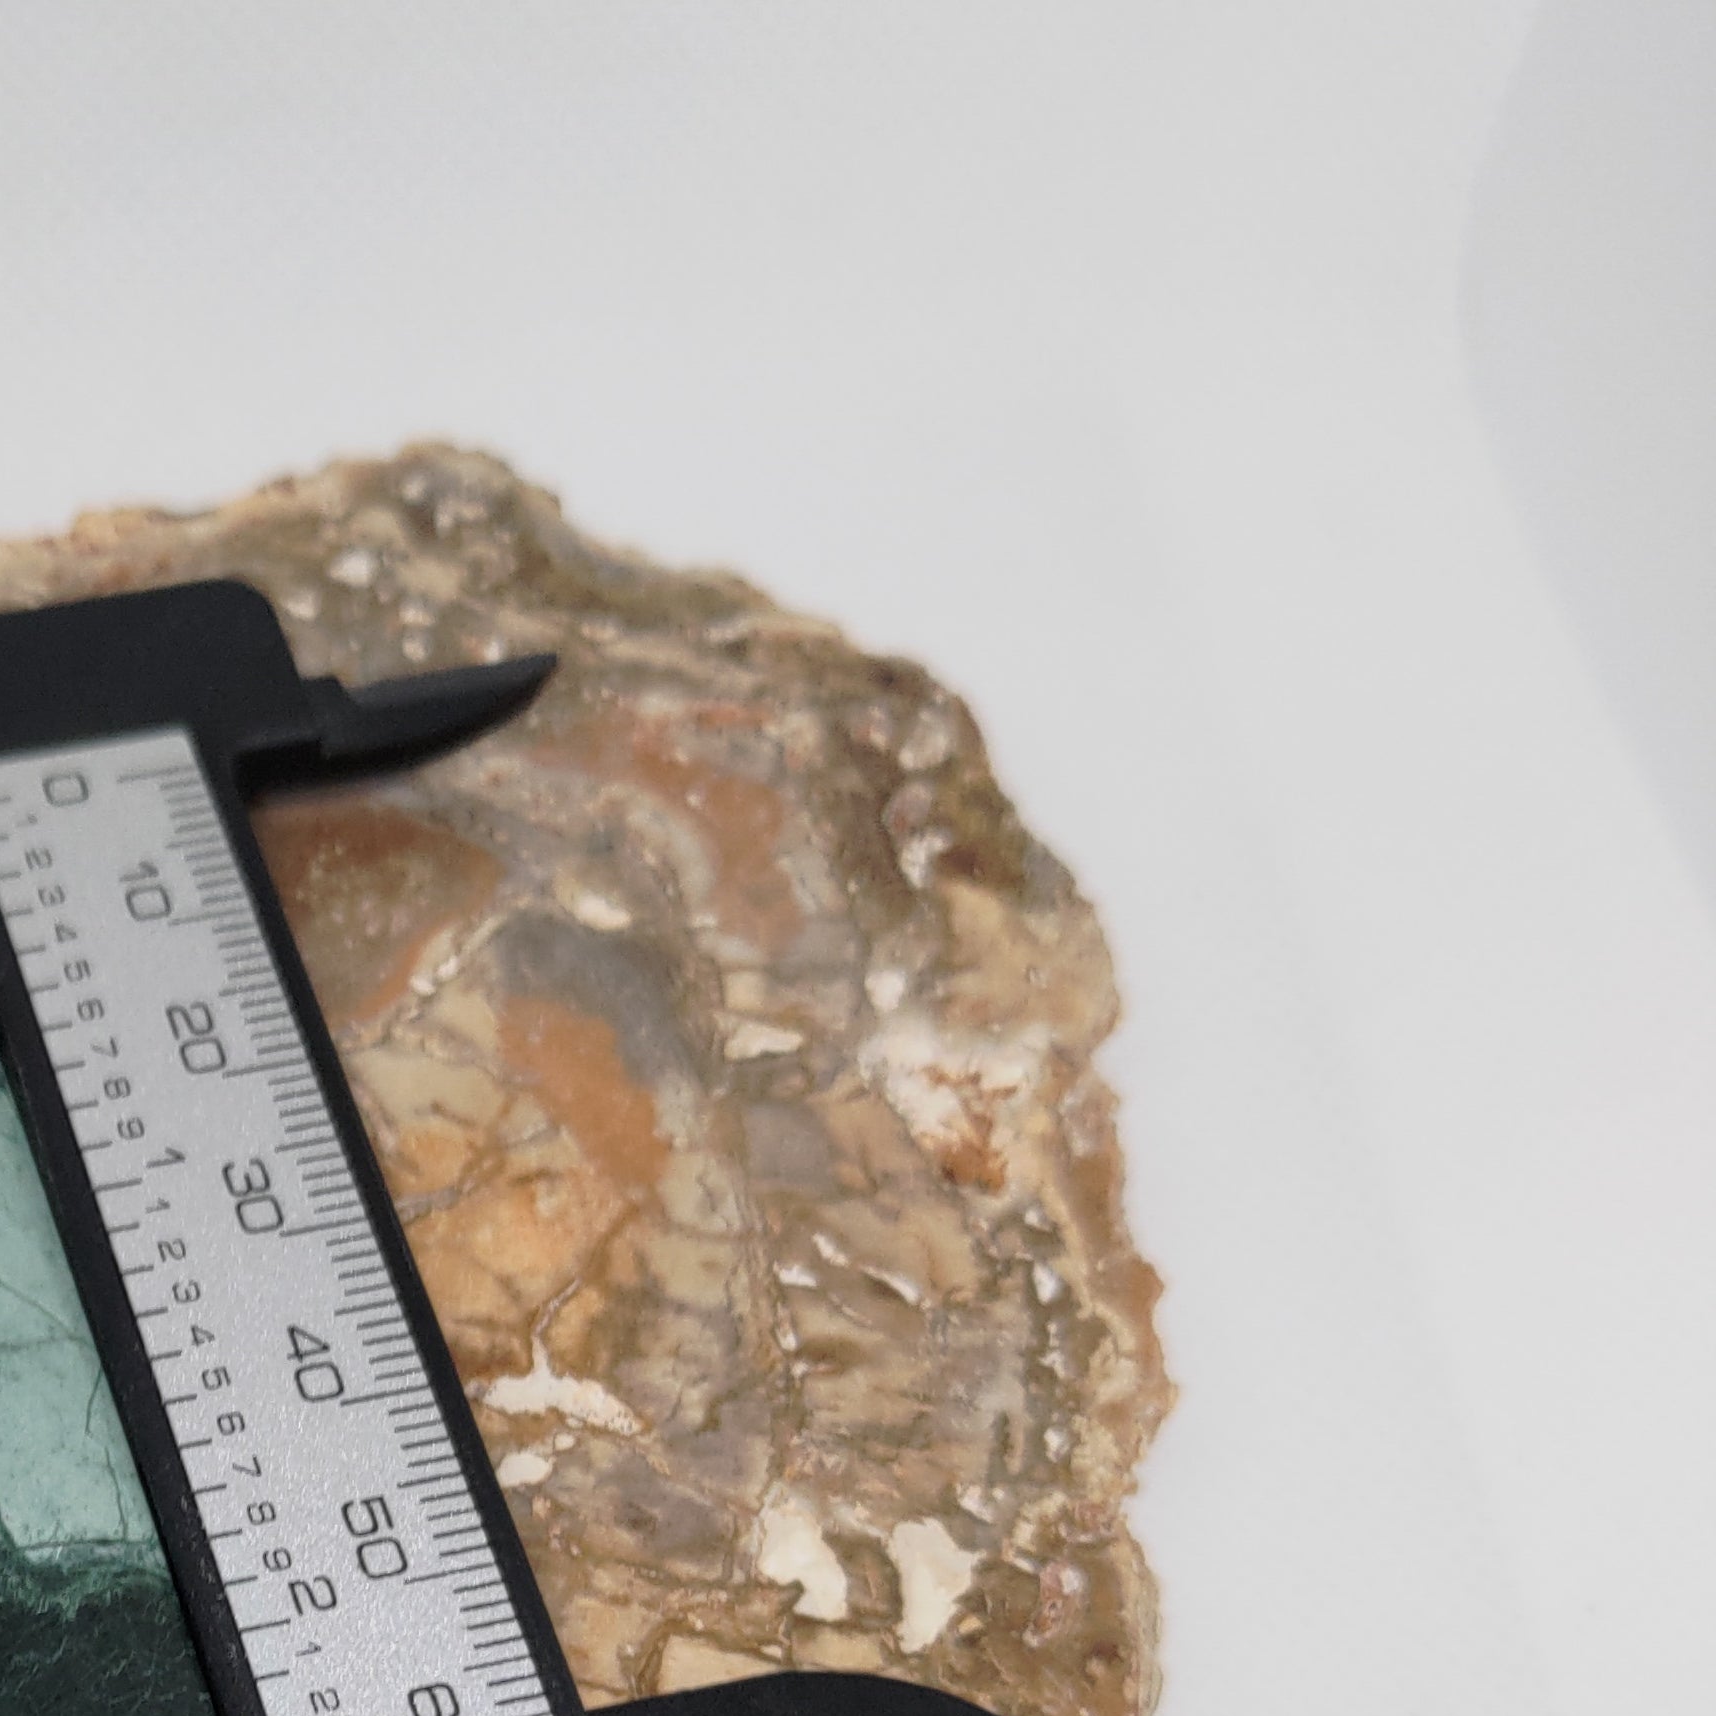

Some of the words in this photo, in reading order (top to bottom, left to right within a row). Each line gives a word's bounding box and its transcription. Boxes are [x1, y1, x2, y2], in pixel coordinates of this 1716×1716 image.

[24, 848, 52, 870] 2
[38, 885, 65, 906] 3
[53, 922, 78, 943] 4
[64, 960, 91, 983] 5
[77, 999, 105, 1021] 6
[91, 1037, 118, 1059] 7
[103, 1077, 131, 1101] 8
[117, 1118, 145, 1140] 9
[146, 1146, 186, 1169] 1
[42, 772, 89, 807] 0
[119, 860, 172, 923] 10
[165, 1001, 227, 1075] 20
[222, 1158, 285, 1235] 30
[286, 1325, 345, 1403] 40
[341, 1496, 408, 1579] 50
[145, 1197, 171, 1214] 1
[157, 1240, 186, 1262] 2
[172, 1280, 201, 1303] 3
[191, 1325, 216, 1347] 4
[202, 1367, 231, 1391] 5
[217, 1411, 246, 1436] 6
[232, 1455, 262, 1479] 7
[246, 1500, 277, 1526] 8
[262, 1546, 292, 1572] 9
[288, 1575, 337, 1616] 2
[295, 1641, 322, 1658] 1
[309, 1688, 340, 1715] 2
